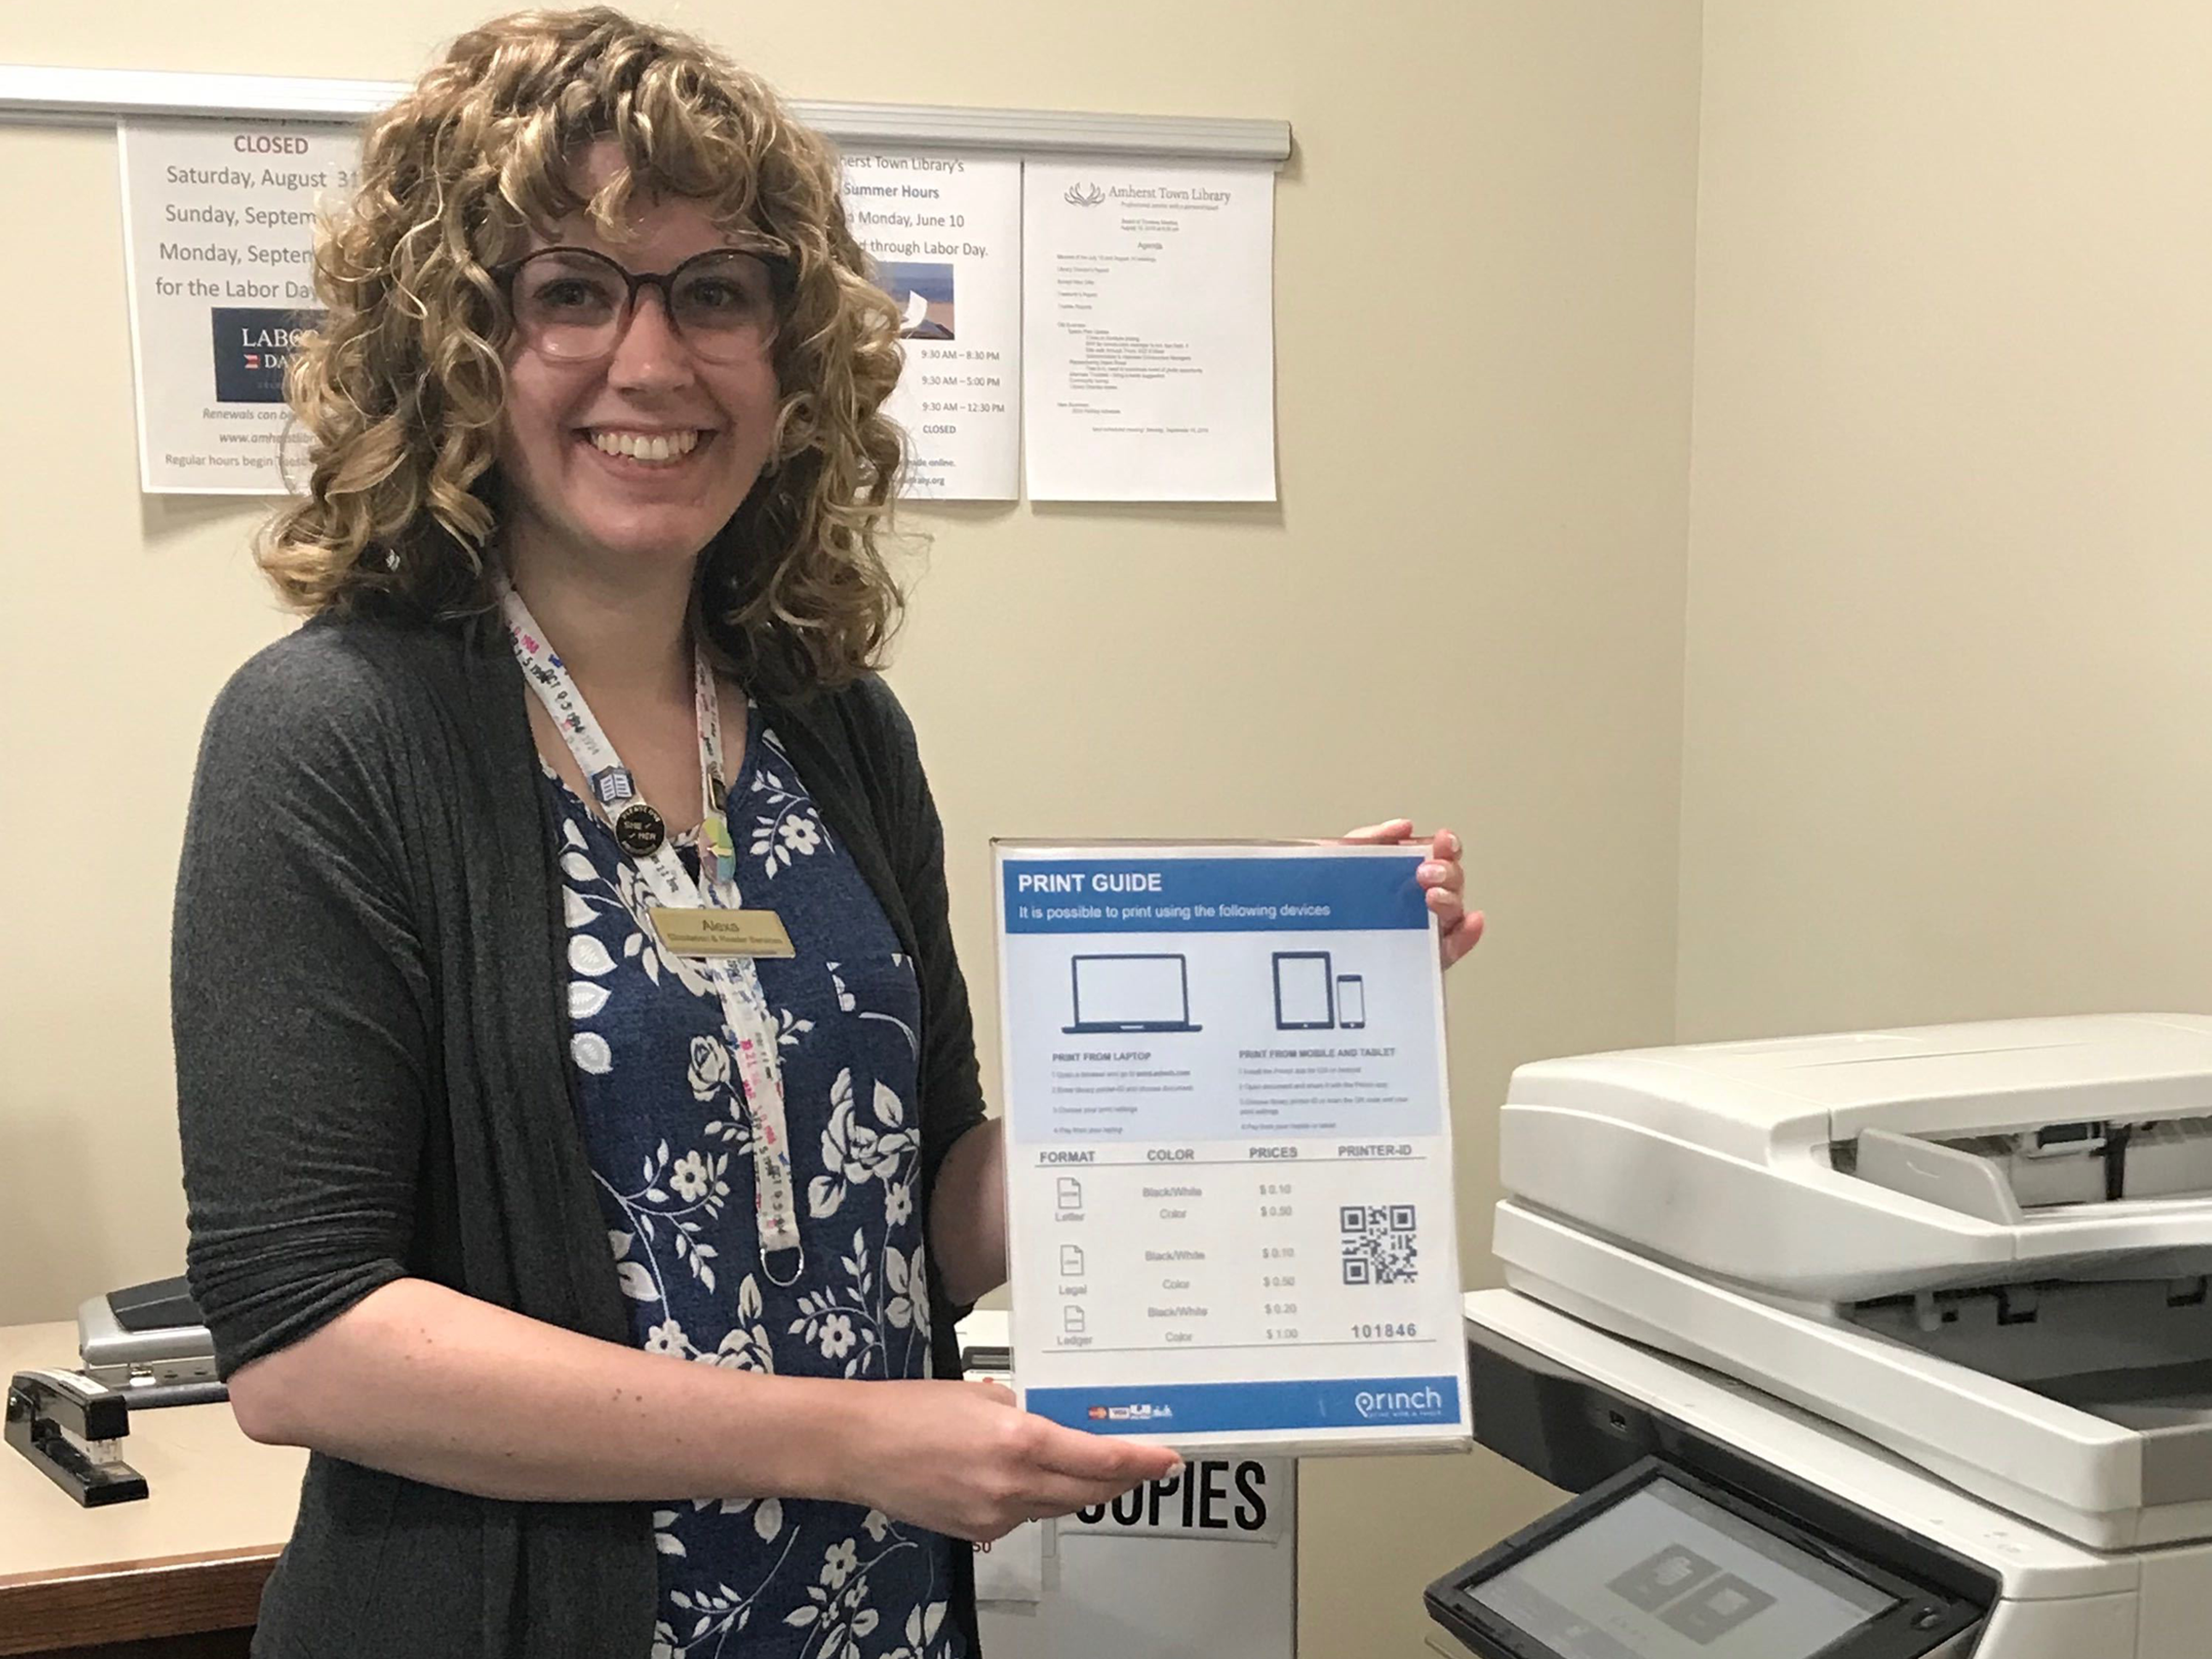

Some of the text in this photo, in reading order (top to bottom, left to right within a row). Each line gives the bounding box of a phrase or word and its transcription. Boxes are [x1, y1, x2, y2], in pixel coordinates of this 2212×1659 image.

[234, 135, 309, 155] CLOSED
[875, 156, 909, 169] Town
[912, 157, 964, 174] Library's
[167, 166, 255, 189] Saturday,
[261, 169, 327, 190] August
[844, 182, 939, 198] Summer Hours
[1109, 185, 1231, 205] Amherst Town Library
[166, 204, 240, 227] Sunday,
[859, 211, 913, 227] Monday,
[916, 214, 945, 227] June
[950, 215, 964, 227] 10
[160, 243, 241, 265] Monday,
[871, 239, 920, 256] through
[924, 242, 959, 255] Labor
[963, 243, 988, 258] Day.
[156, 277, 183, 296] for
[188, 279, 219, 297] the
[227, 280, 279, 298] Labor
[942, 350, 957, 359] AM
[986, 352, 999, 360] PM
[942, 377, 958, 385] AM
[987, 378, 1000, 386] PM
[203, 408, 254, 420] Renewals
[257, 410, 277, 420] can
[943, 403, 958, 411] AM
[992, 404, 1005, 413] PM
[923, 425, 956, 433] CLOSED
[166, 454, 205, 468] Regular
[209, 456, 240, 467] hours
[243, 457, 273, 468] begin
[1019, 873, 1162, 892] PRINT GUIDE
[1020, 904, 1331, 920] It is possible to print using the following devices
[702, 919, 740, 932] Alexa
[1052, 1052, 1151, 1061] PRINT FROM LAPTOP
[1238, 1047, 1395, 1058] PRINT FROM MOBILE AND TABLET
[1147, 1149, 1195, 1161] COLOR
[1249, 1147, 1298, 1158] PRICES
[1338, 1145, 1412, 1156] PRINTER-ID
[1040, 1151, 1095, 1163] FORMAT
[1142, 1187, 1202, 1198] Black/White
[1260, 1185, 1266, 1195] $
[1055, 1212, 1085, 1222] Letter
[1159, 1208, 1187, 1219] Color
[1261, 1206, 1267, 1216] $
[1145, 1250, 1205, 1262] Black/White
[1262, 1248, 1269, 1258] $
[1059, 1284, 1087, 1296] Legal
[1162, 1279, 1190, 1290] Color
[1148, 1307, 1208, 1318] Black/White
[1267, 1329, 1273, 1339] $
[1351, 1323, 1417, 1339] 101846
[1057, 1335, 1093, 1347] Ledger
[1165, 1332, 1192, 1343] Color
